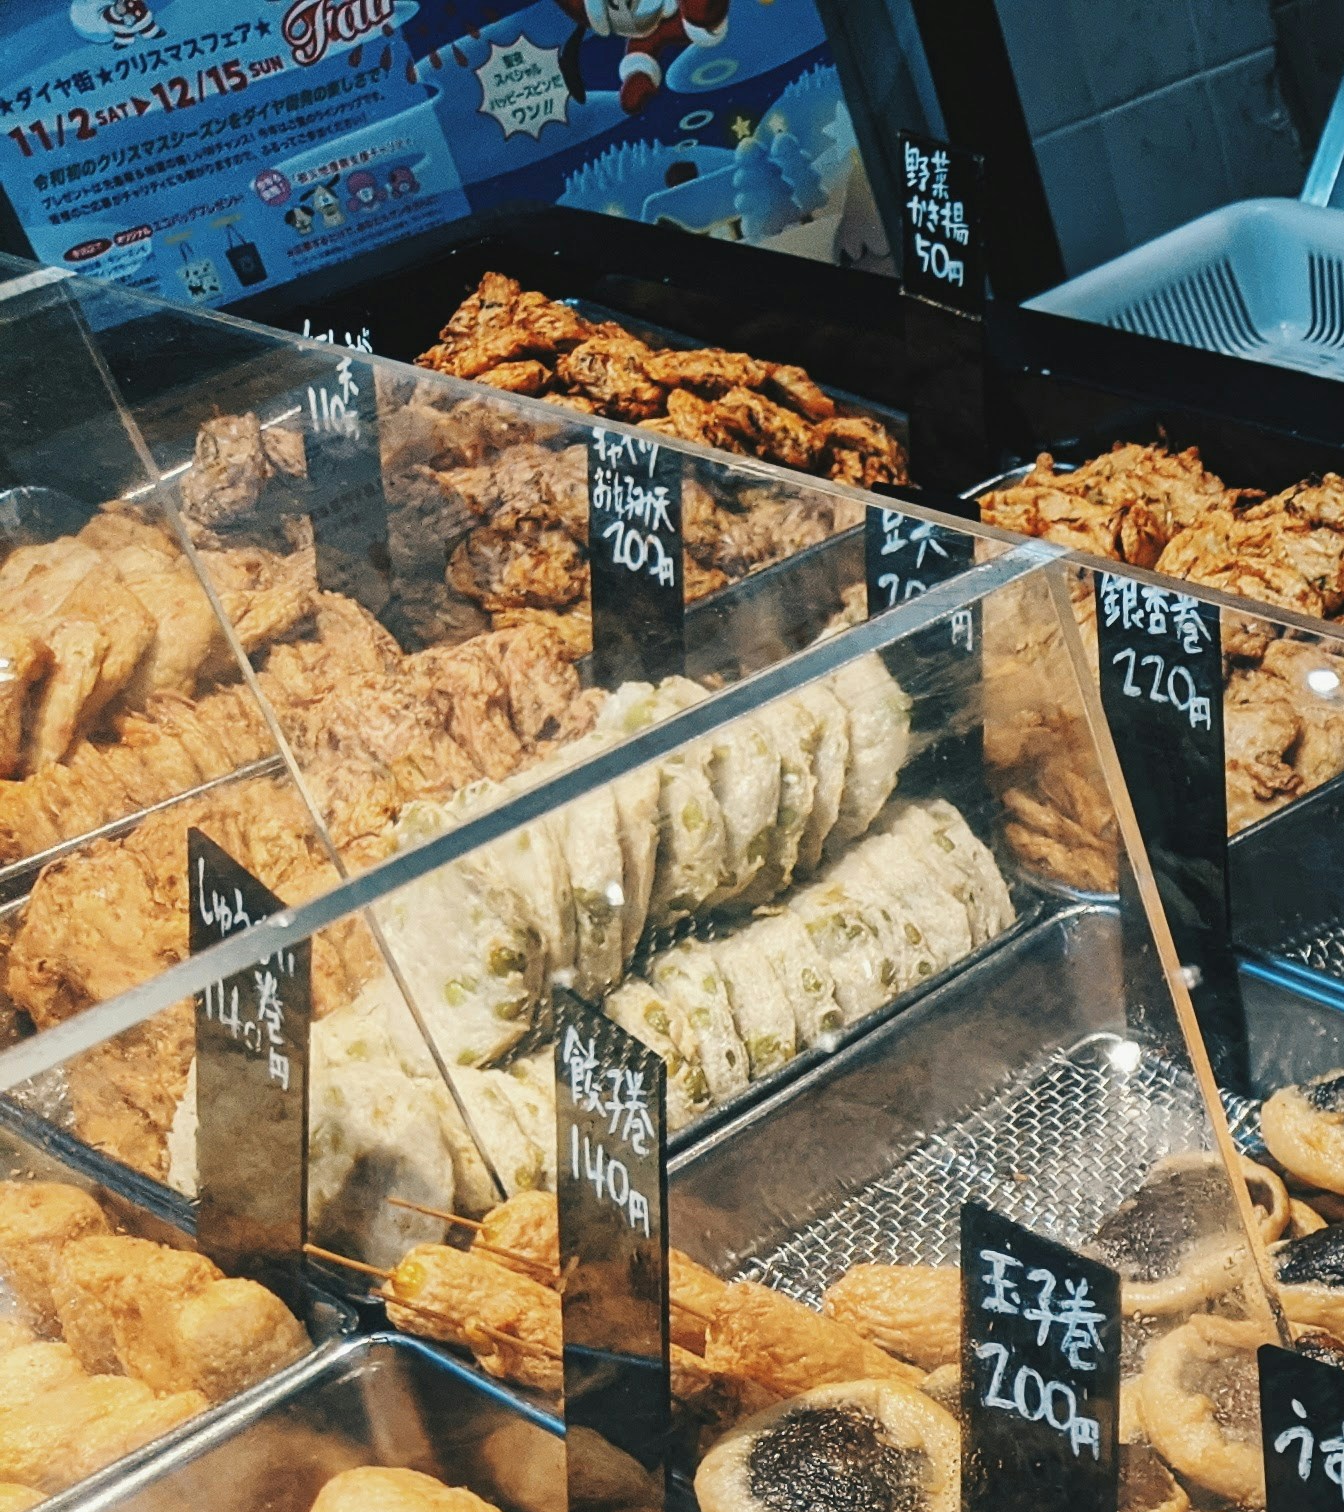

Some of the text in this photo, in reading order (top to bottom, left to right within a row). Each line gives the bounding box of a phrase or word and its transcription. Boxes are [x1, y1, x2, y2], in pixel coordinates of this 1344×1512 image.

[8, 55, 284, 157] 11/2 SAT 12/15 SUN
[905, 141, 950, 199] 野菜
[906, 195, 969, 245] かき揚
[915, 233, 964, 287] 50円
[602, 520, 674, 587] 200円
[1112, 648, 1211, 730] 220円
[572, 1124, 649, 1239] 140円
[980, 1250, 1107, 1371] 玉子巻
[975, 1342, 1099, 1461] 200円
